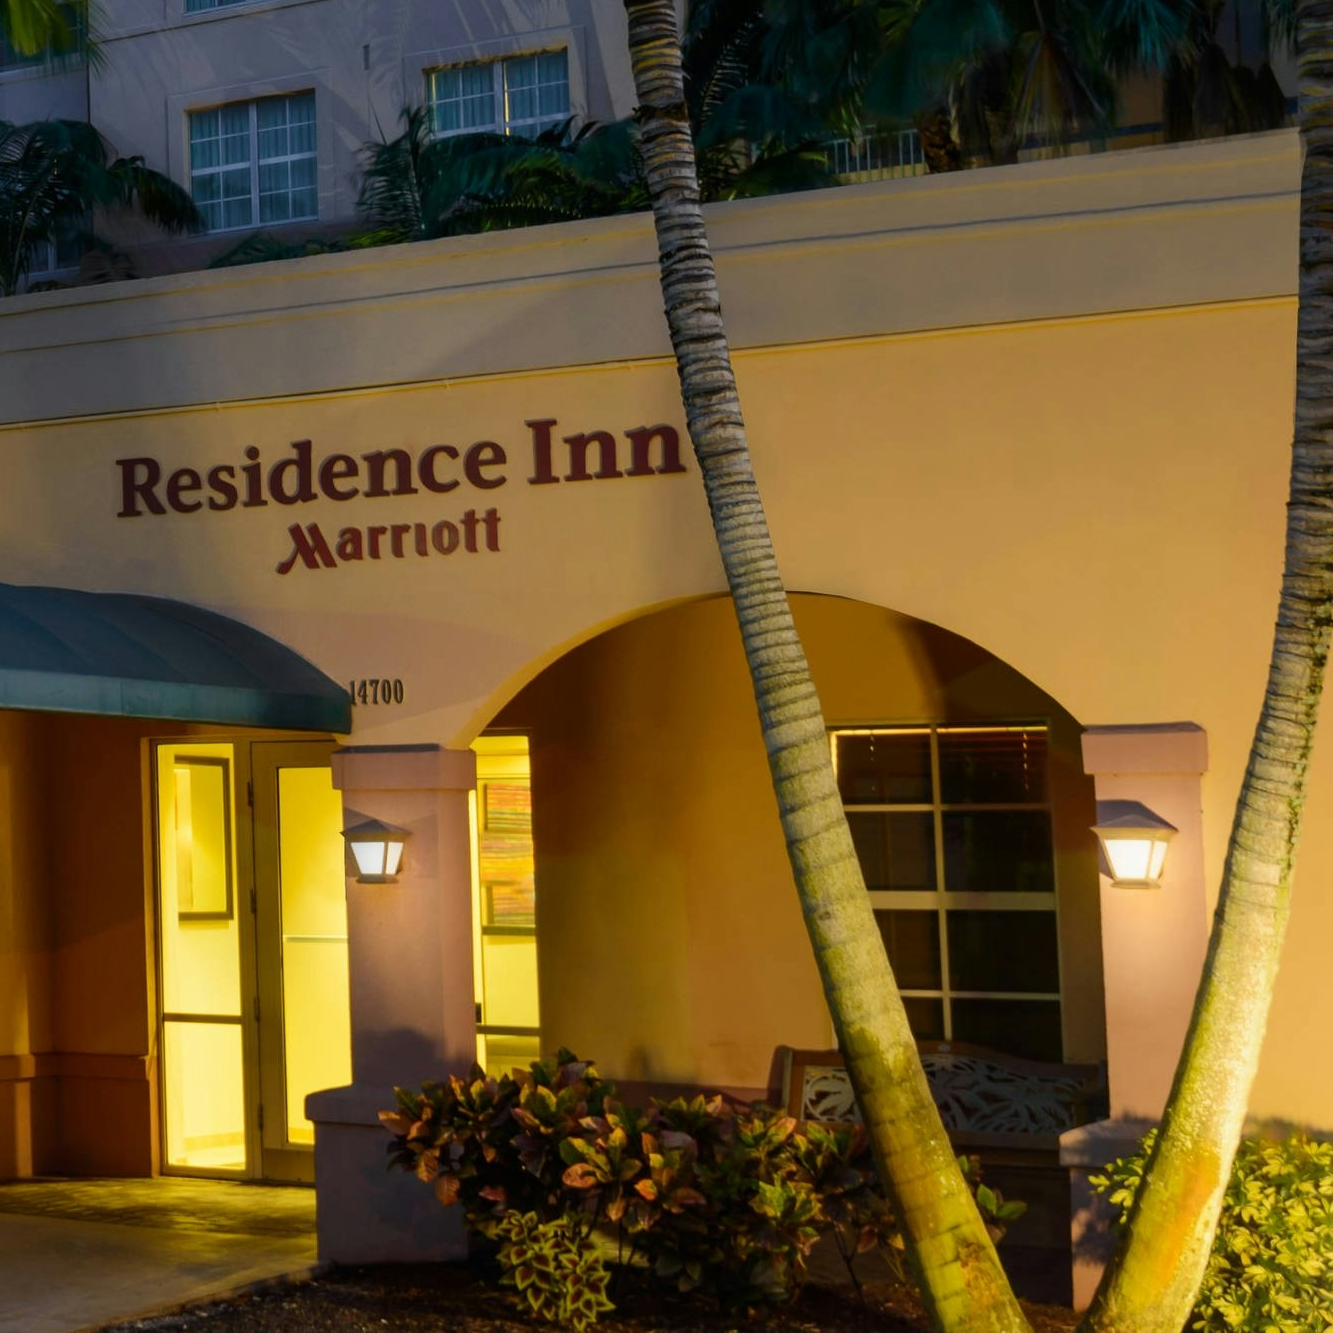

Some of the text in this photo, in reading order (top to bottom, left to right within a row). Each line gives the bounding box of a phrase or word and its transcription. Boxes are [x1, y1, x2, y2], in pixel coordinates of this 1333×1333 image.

[117, 418, 687, 518] Residence Inn
[276, 508, 501, 575] Marriott
[349, 678, 404, 706] 14700
